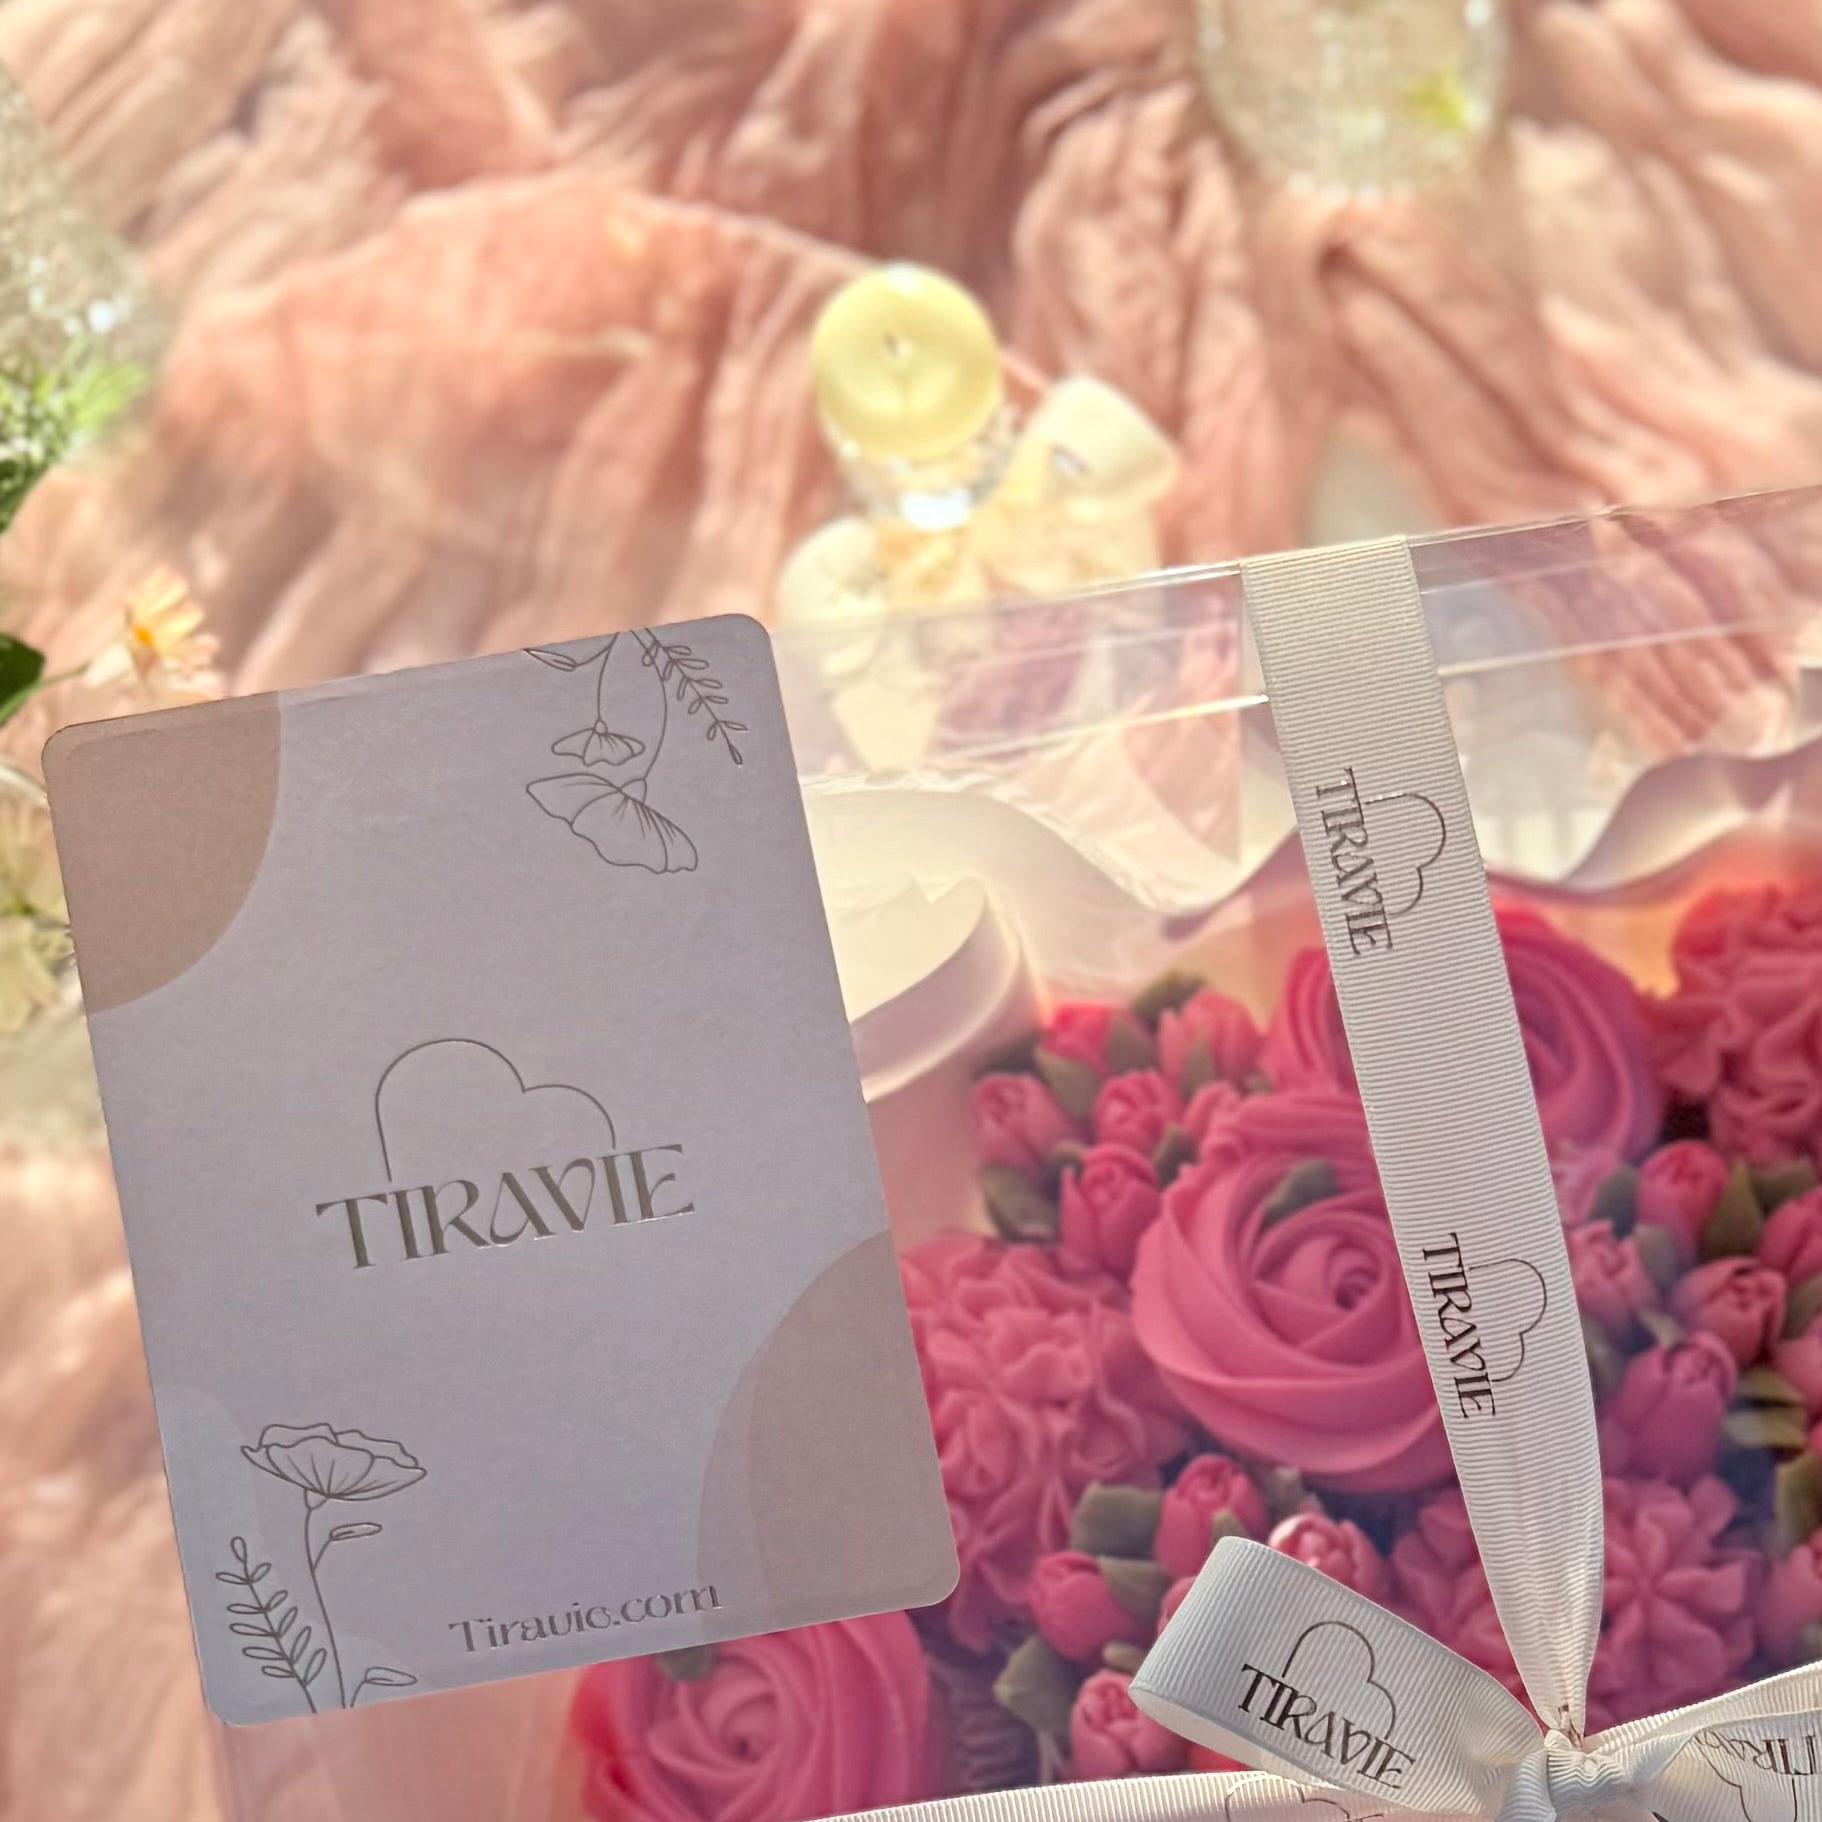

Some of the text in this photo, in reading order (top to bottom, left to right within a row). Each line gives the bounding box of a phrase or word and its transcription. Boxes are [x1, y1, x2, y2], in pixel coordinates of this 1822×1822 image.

[1315, 766, 1393, 957] TIRAVIE
[316, 1143, 695, 1269] TIRAVIE
[1422, 1232, 1496, 1418] TIRAVIE
[1237, 1663, 1416, 1790] TIRAVIE
